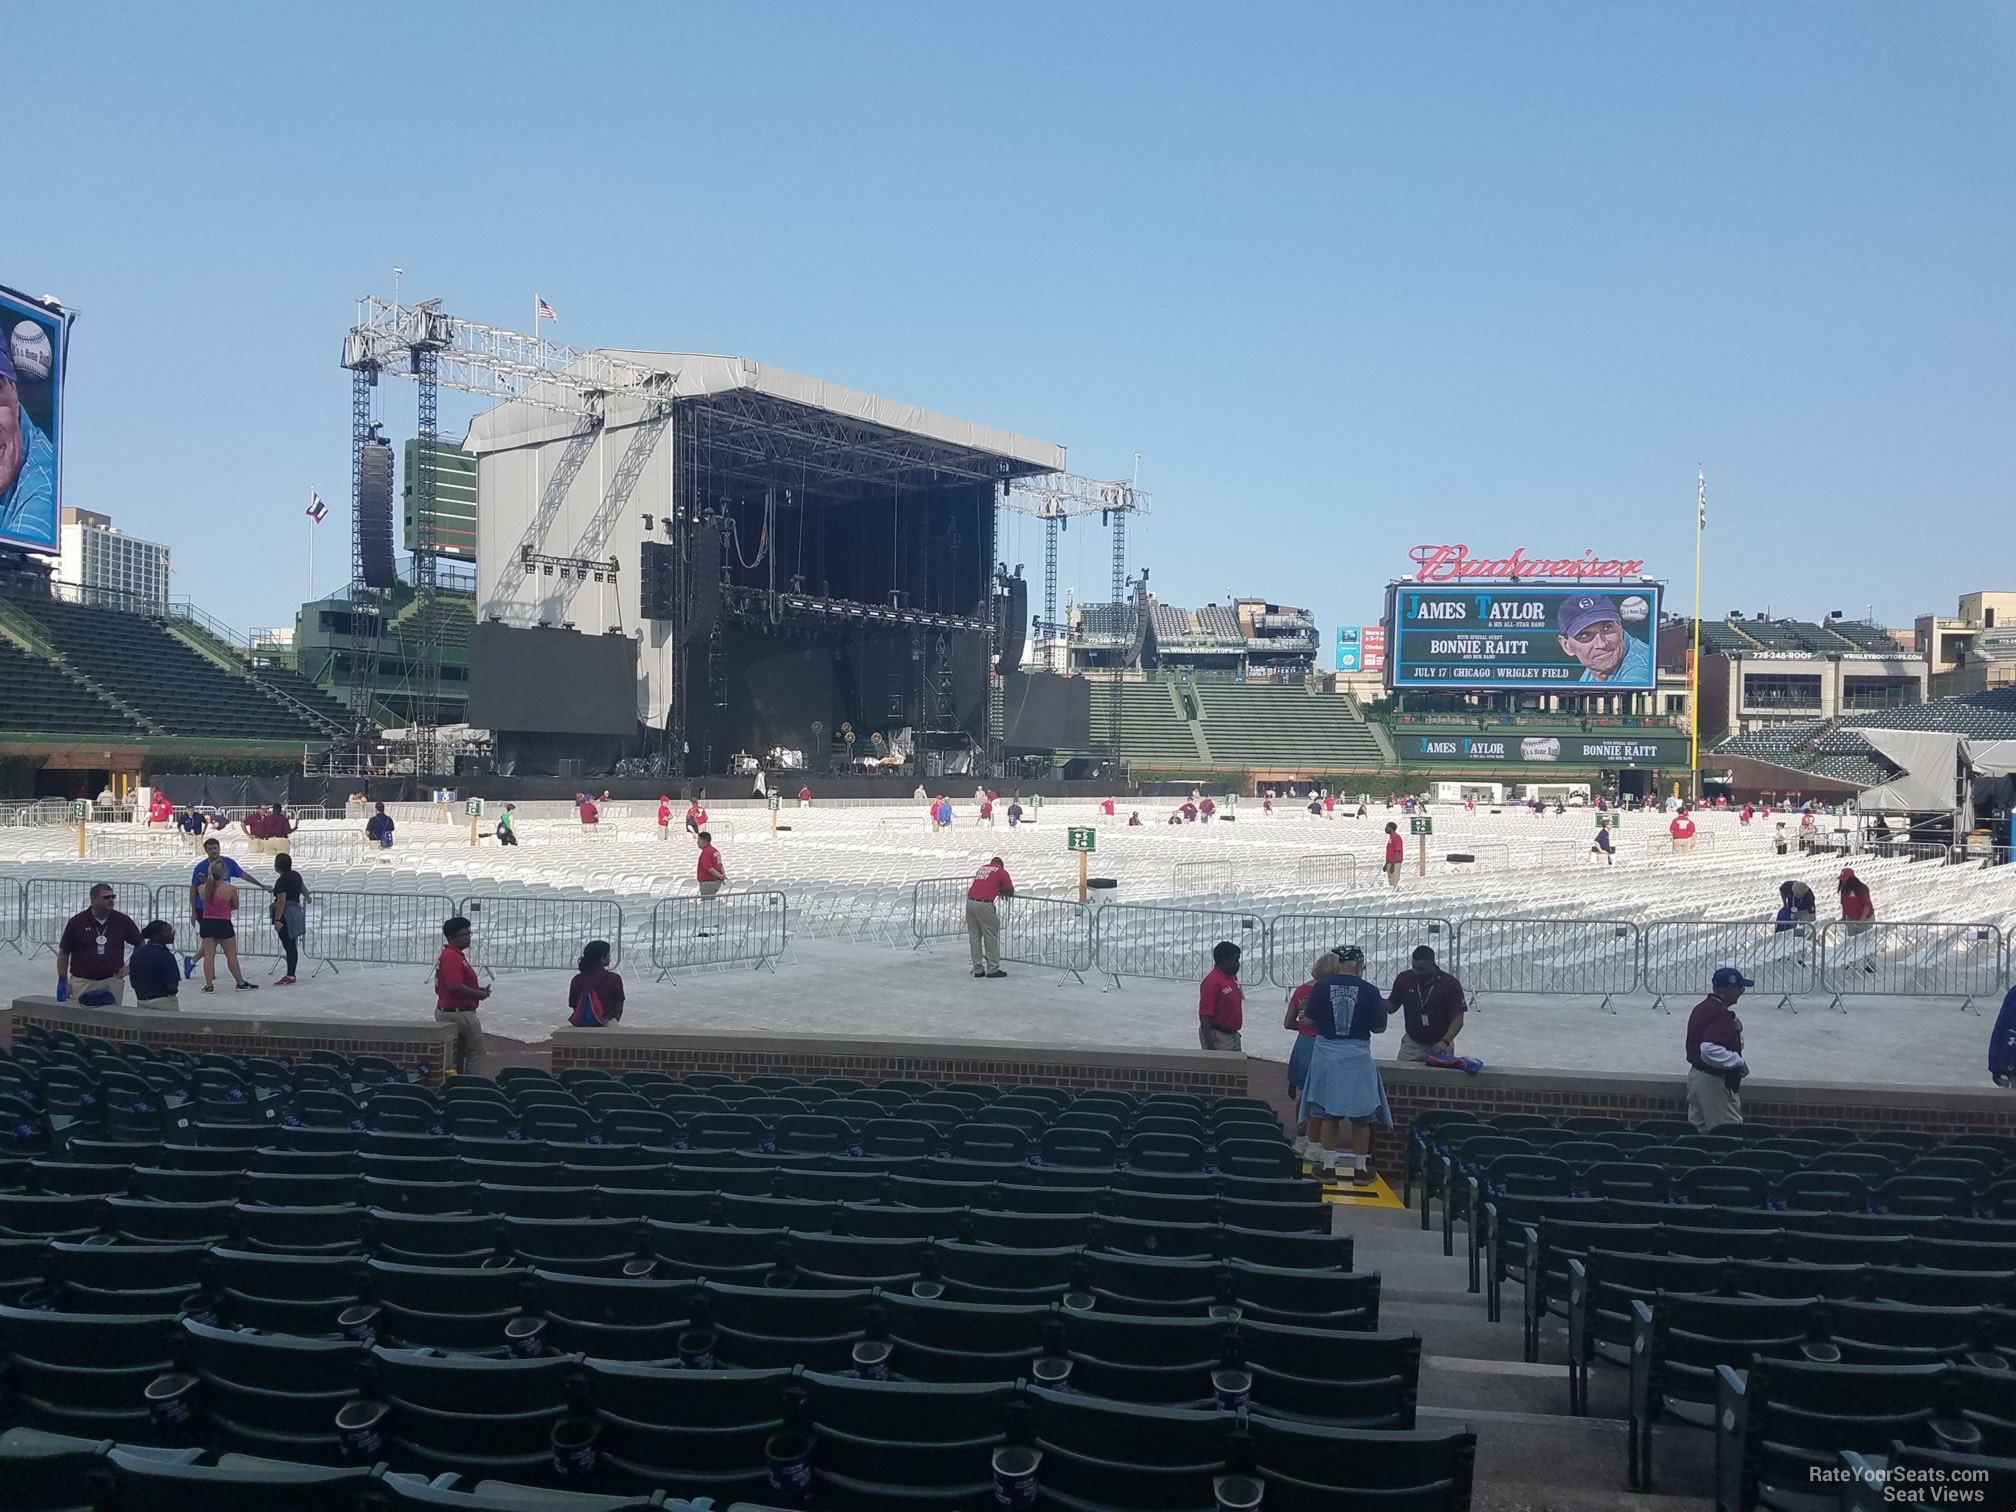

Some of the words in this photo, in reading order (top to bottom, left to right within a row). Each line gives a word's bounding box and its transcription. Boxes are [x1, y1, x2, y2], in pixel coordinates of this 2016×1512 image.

[1408, 543, 1644, 582] Budweiser
[1407, 595, 1466, 619] JAMES
[1475, 595, 1545, 620] TAYLOR
[1430, 640, 1481, 654] BONNIE
[1485, 640, 1529, 654] RAITT
[1414, 667, 1436, 677] JULY
[1438, 668, 1447, 677] 17
[1453, 668, 1491, 677] CHICAGO
[1497, 668, 1539, 678] WRIGLEY
[1542, 668, 1569, 678] FIELD
[1420, 737, 1456, 753] JAMES
[1461, 737, 1504, 754] TAYLOR
[1583, 745, 1622, 756] BONNIE
[1624, 745, 1658, 756] RAITT
